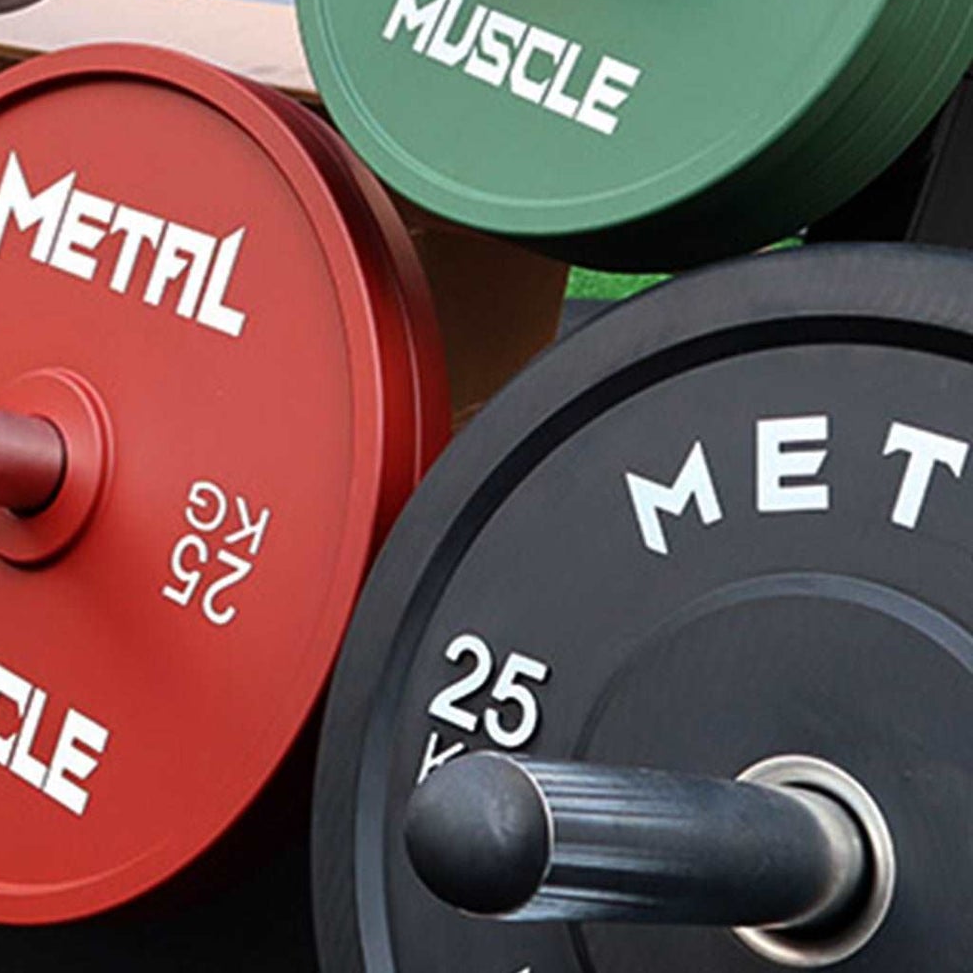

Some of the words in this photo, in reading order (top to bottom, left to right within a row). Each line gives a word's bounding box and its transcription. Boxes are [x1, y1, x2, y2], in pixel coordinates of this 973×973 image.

[184, 480, 269, 555] KG
[626, 415, 970, 555] MET
[162, 533, 253, 626] 25
[427, 633, 549, 749] 25
